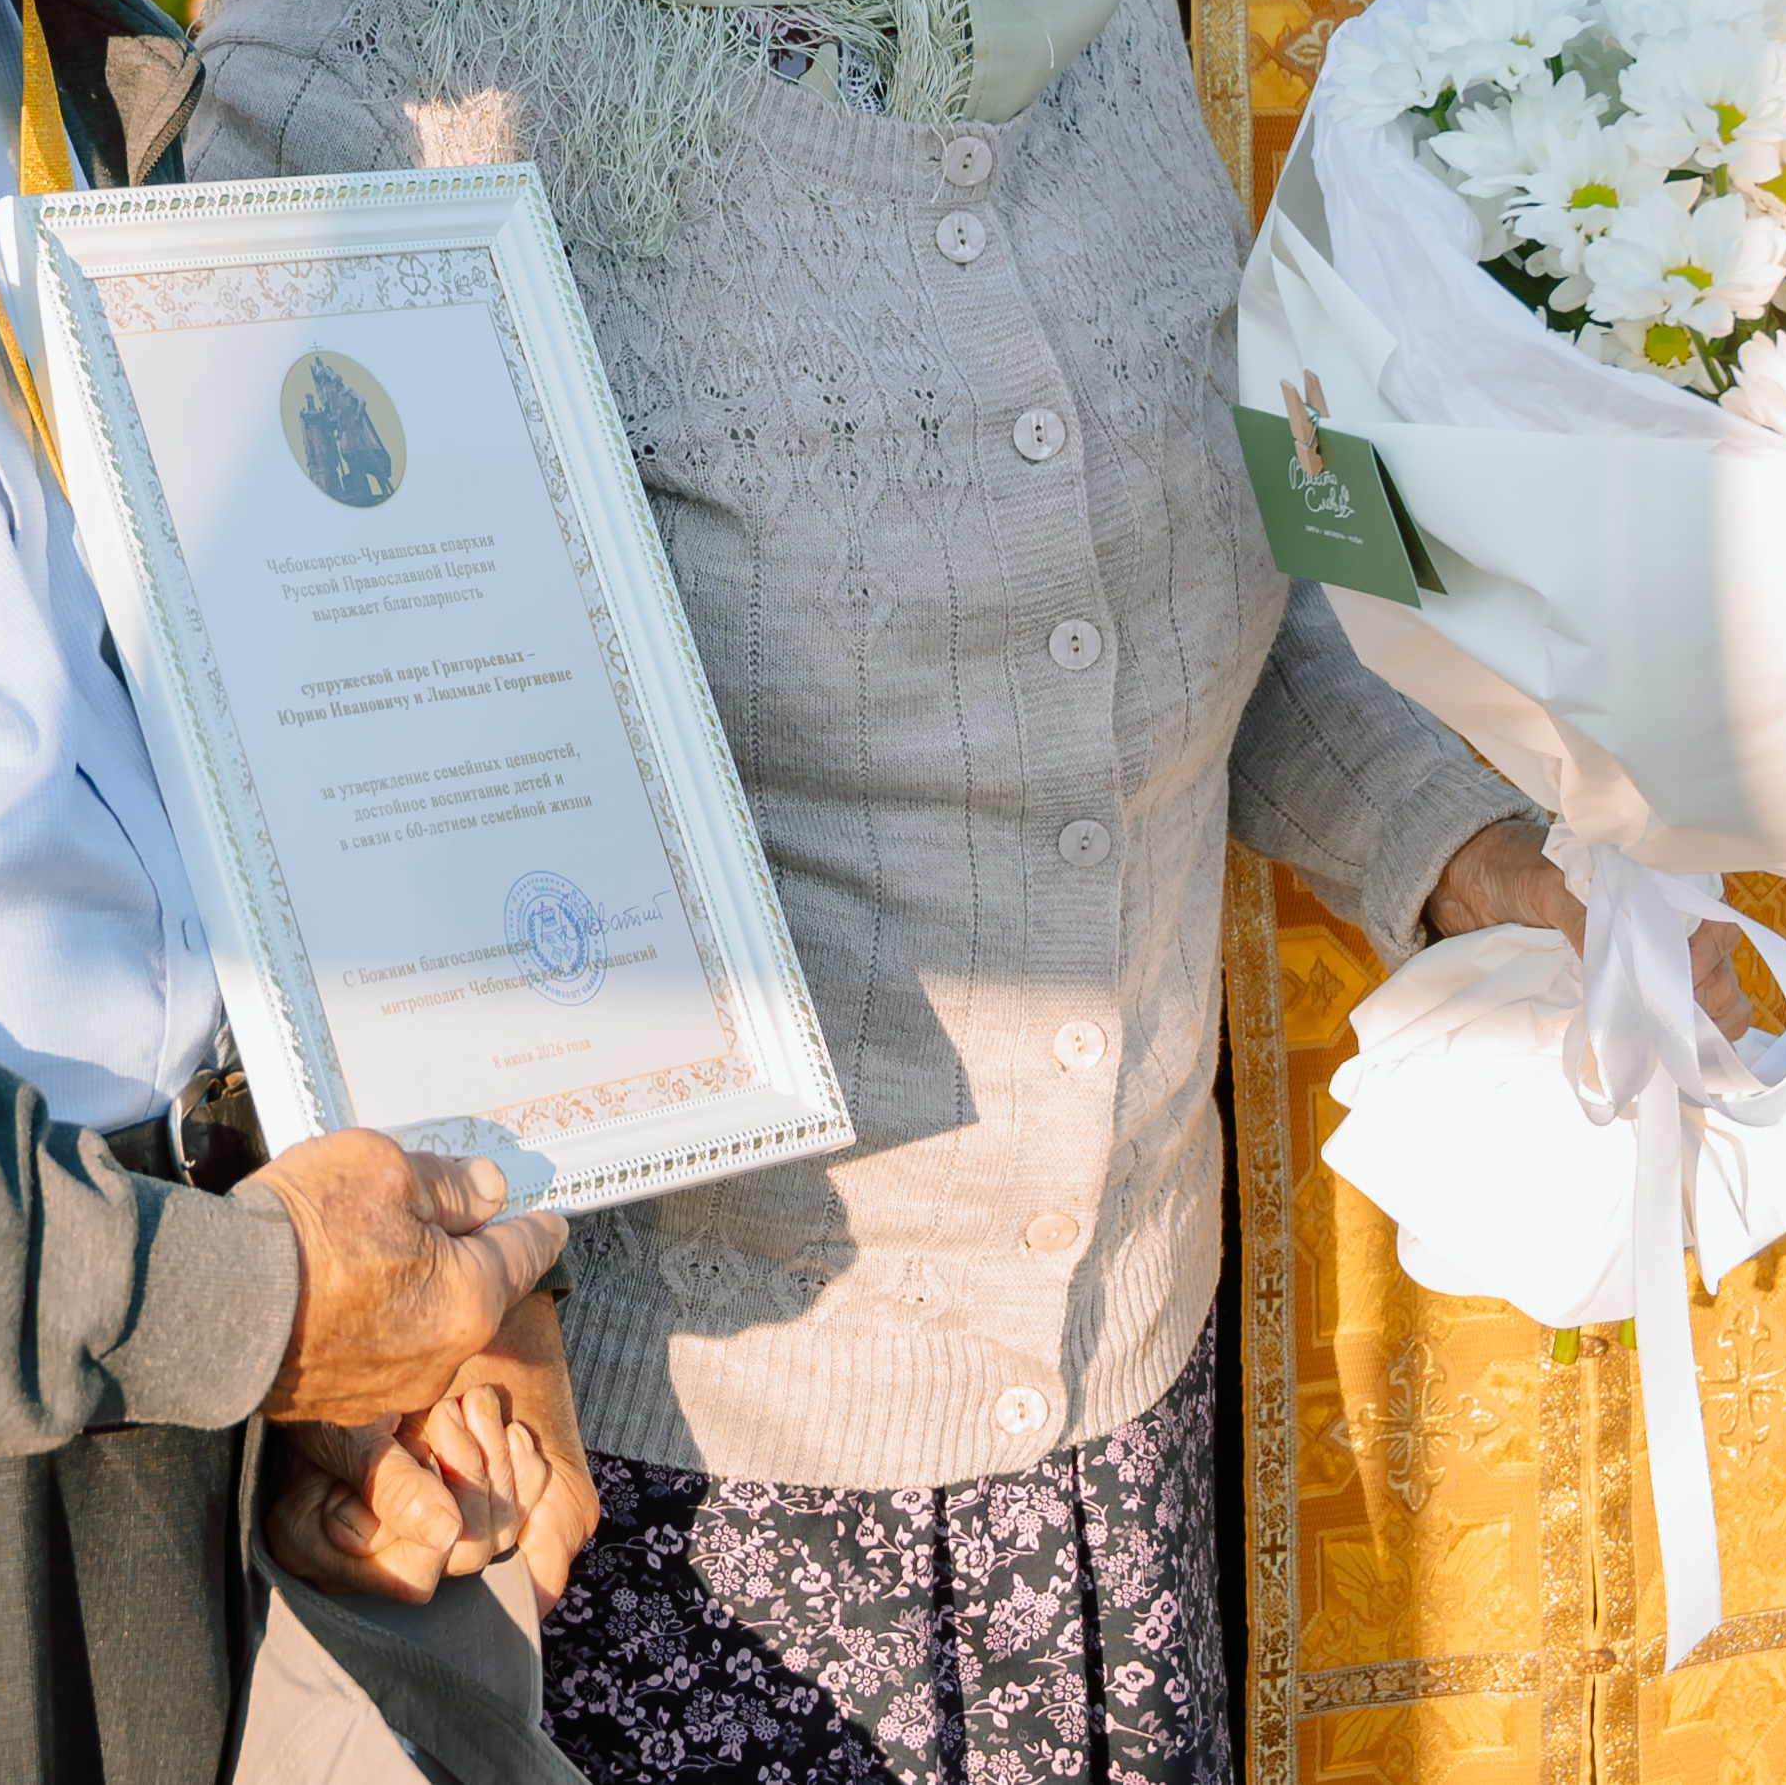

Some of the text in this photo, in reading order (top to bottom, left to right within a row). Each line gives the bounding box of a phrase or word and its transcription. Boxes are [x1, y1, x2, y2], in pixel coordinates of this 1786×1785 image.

[267, 535, 495, 575] Чебоксарско-Чувашская епархия
[281, 560, 496, 602] Русской Православной Церкви
[312, 586, 484, 623] выражает благодарность
[276, 668, 573, 727] Юрию Ивановичу и Людмиле Георгиевне
[301, 668, 394, 699] супружеской
[396, 664, 431, 683] паре
[431, 650, 525, 678] Григорьевых
[319, 742, 581, 801] за утверждение семейных ценностей,
[353, 772, 565, 823] достойное воспитание детей и
[339, 794, 593, 852] в связи с 60-летием семейной жизни
[342, 970, 356, 988] С
[359, 964, 417, 986] Божиим
[380, 987, 465, 1016] митрополит
[581, 944, 658, 973] Чувашский
[492, 1037, 592, 1070] 8 июля 2026 года
